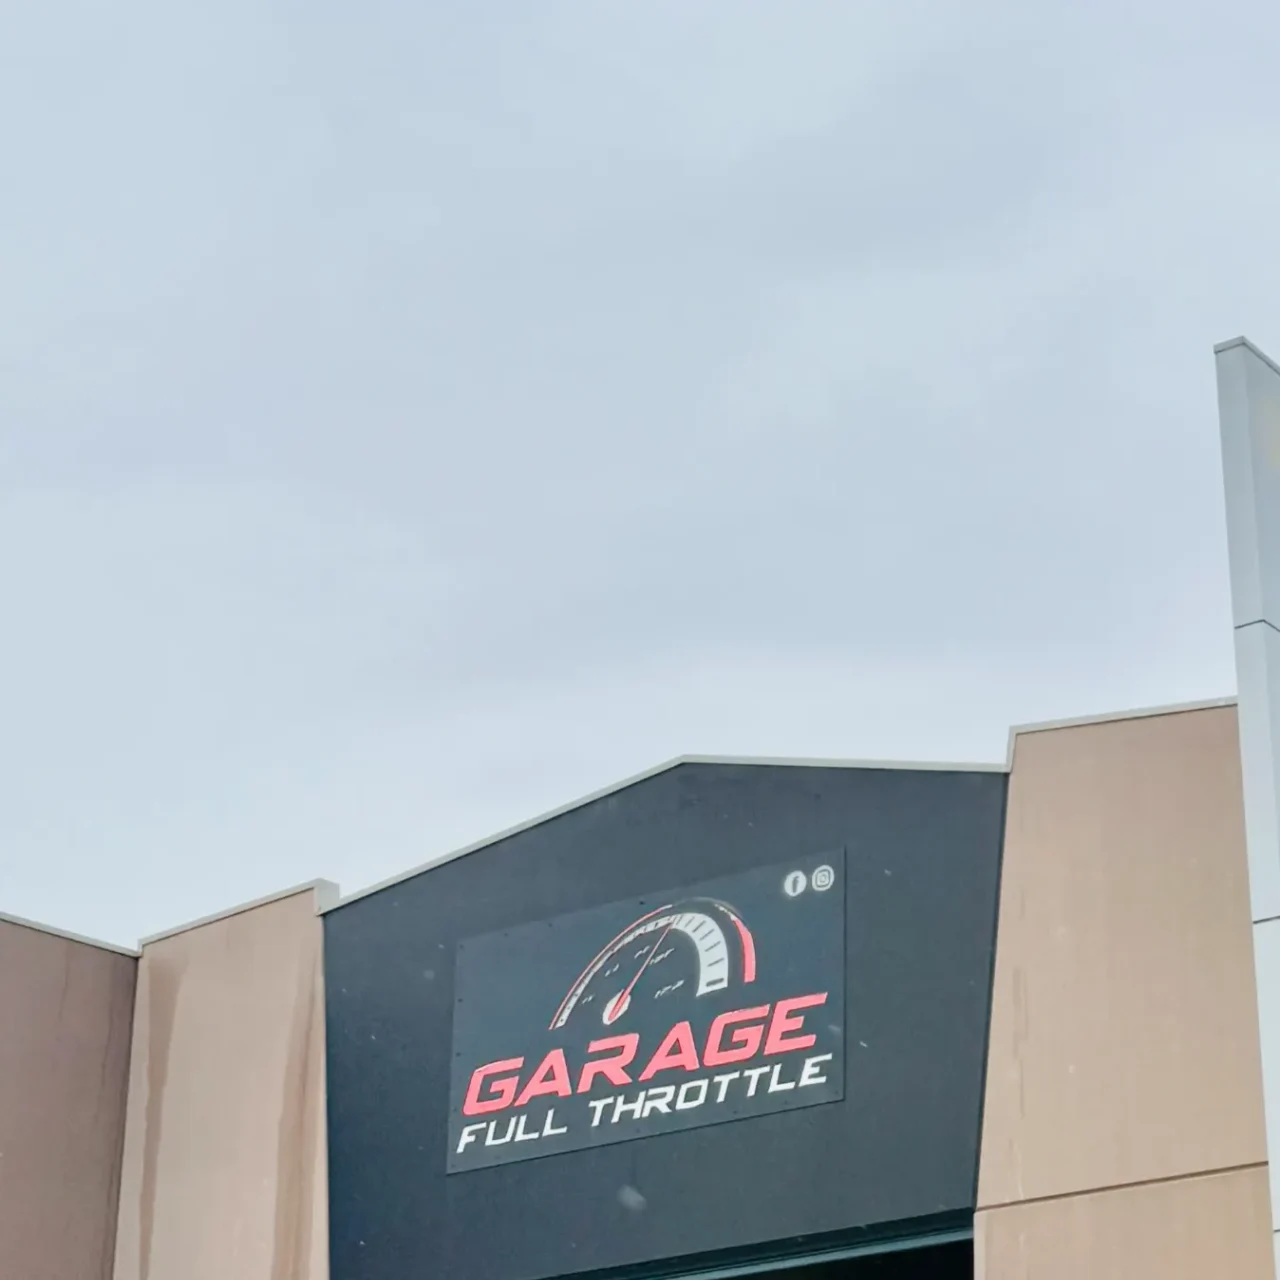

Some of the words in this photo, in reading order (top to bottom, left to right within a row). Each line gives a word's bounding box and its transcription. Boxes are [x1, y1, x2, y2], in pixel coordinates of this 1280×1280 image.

[456, 1108, 568, 1154] FULL
[588, 1053, 833, 1127] THROTTLE
[462, 992, 829, 1117] GARAGE
